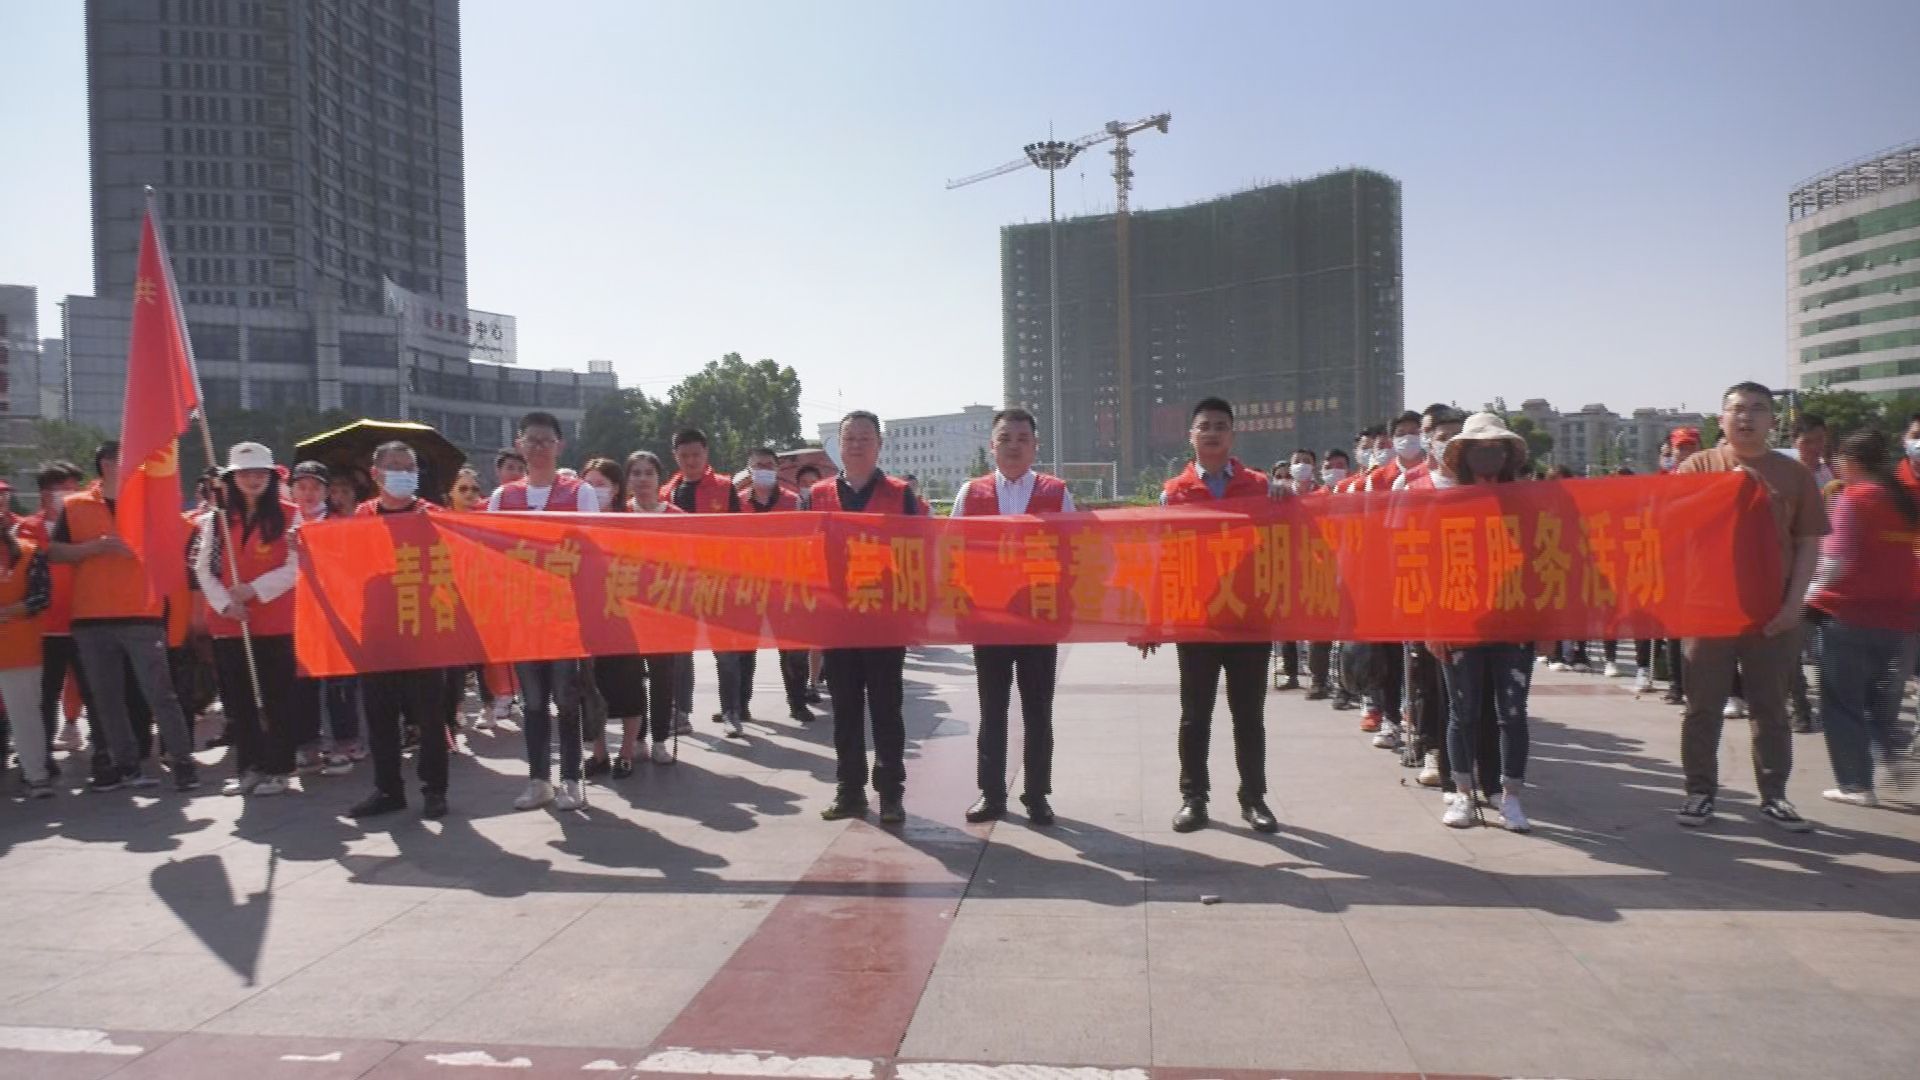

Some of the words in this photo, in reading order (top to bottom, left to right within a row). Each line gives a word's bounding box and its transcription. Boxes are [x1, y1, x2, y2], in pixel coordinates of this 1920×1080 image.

[846, 531, 971, 615] 崇阳县
[1392, 511, 1666, 614] 志愿服务活动
